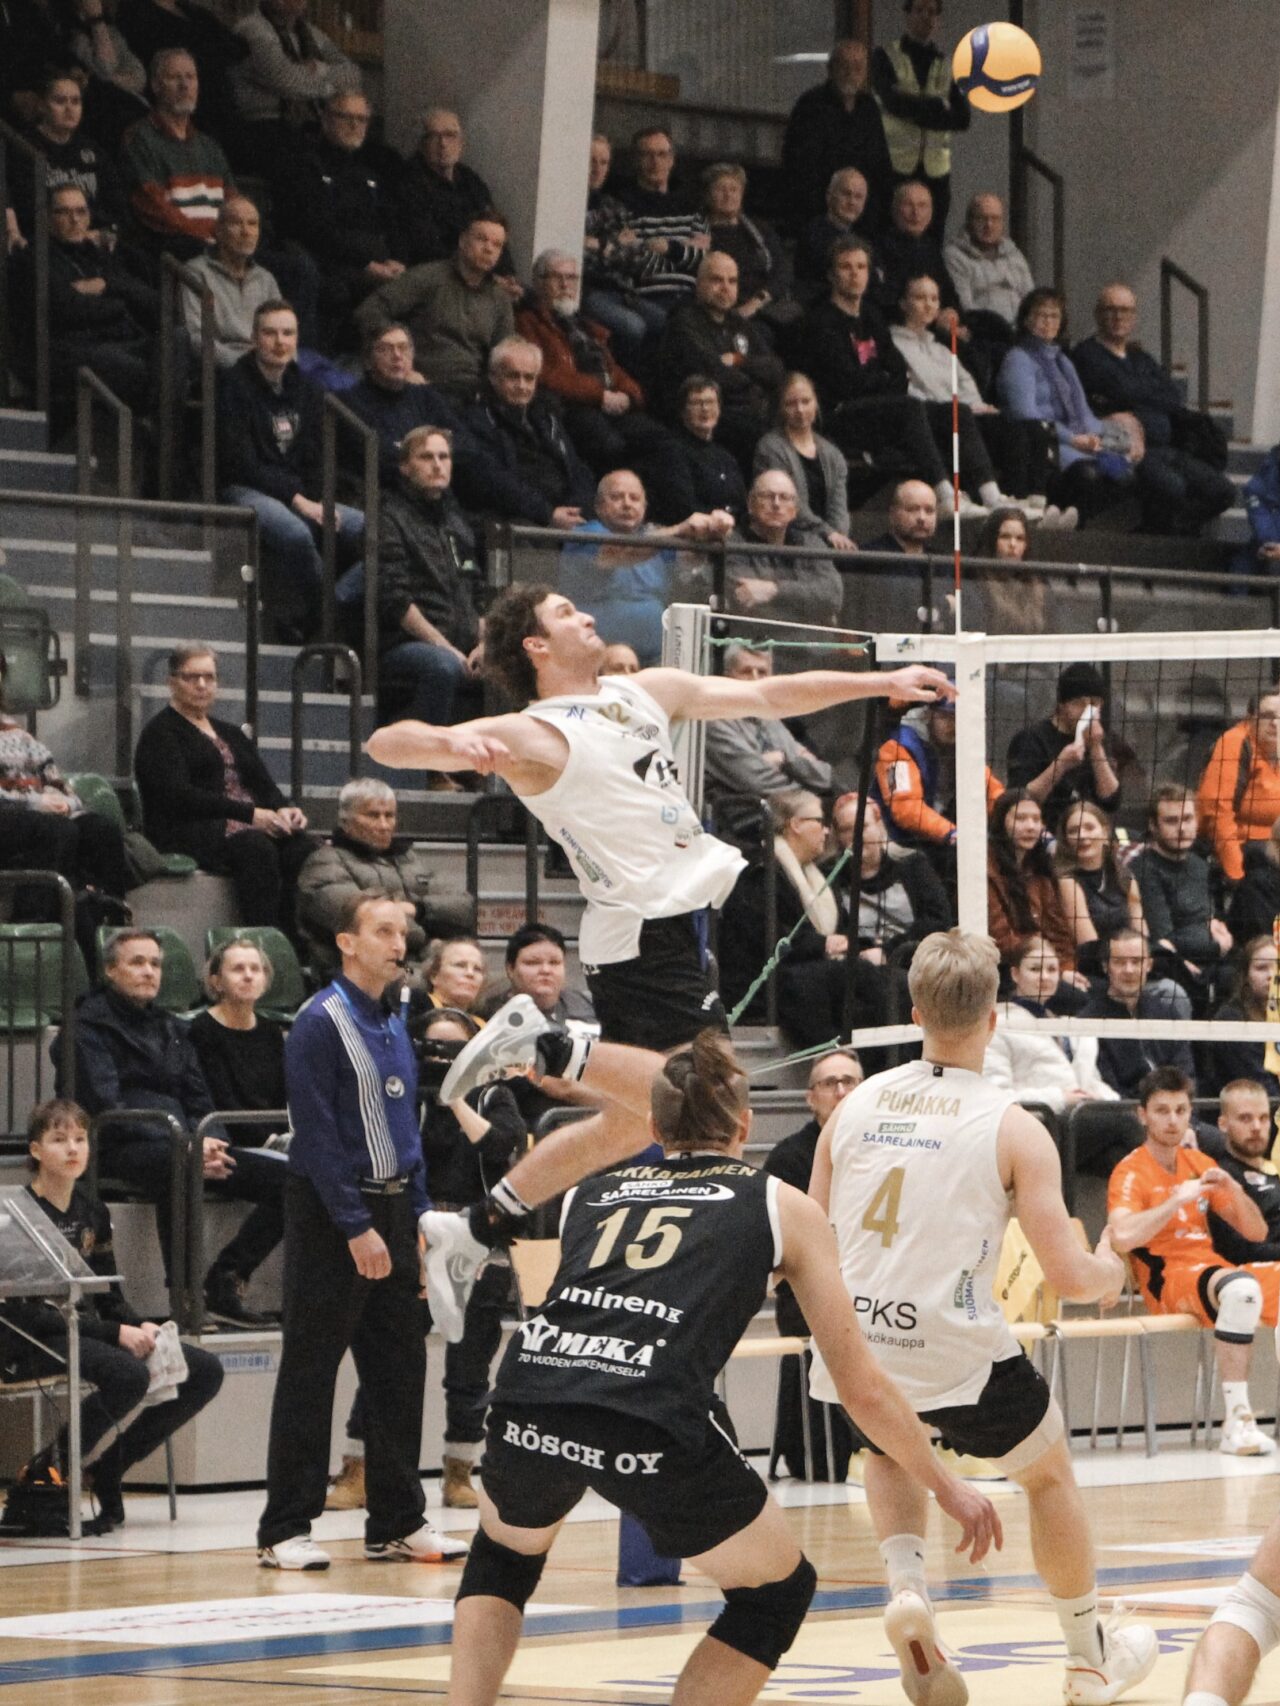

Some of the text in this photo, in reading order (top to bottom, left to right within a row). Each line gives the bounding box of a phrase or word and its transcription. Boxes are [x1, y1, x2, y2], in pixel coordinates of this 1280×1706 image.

[875, 1088, 961, 1118] PUHAKKA
[862, 1132, 942, 1150] SAARELAINEN
[600, 1186, 711, 1203] SAARELAINEN
[861, 1166, 906, 1249] 4
[588, 1205, 693, 1270] 15
[502, 1420, 664, 1475] RÖSCH OY
